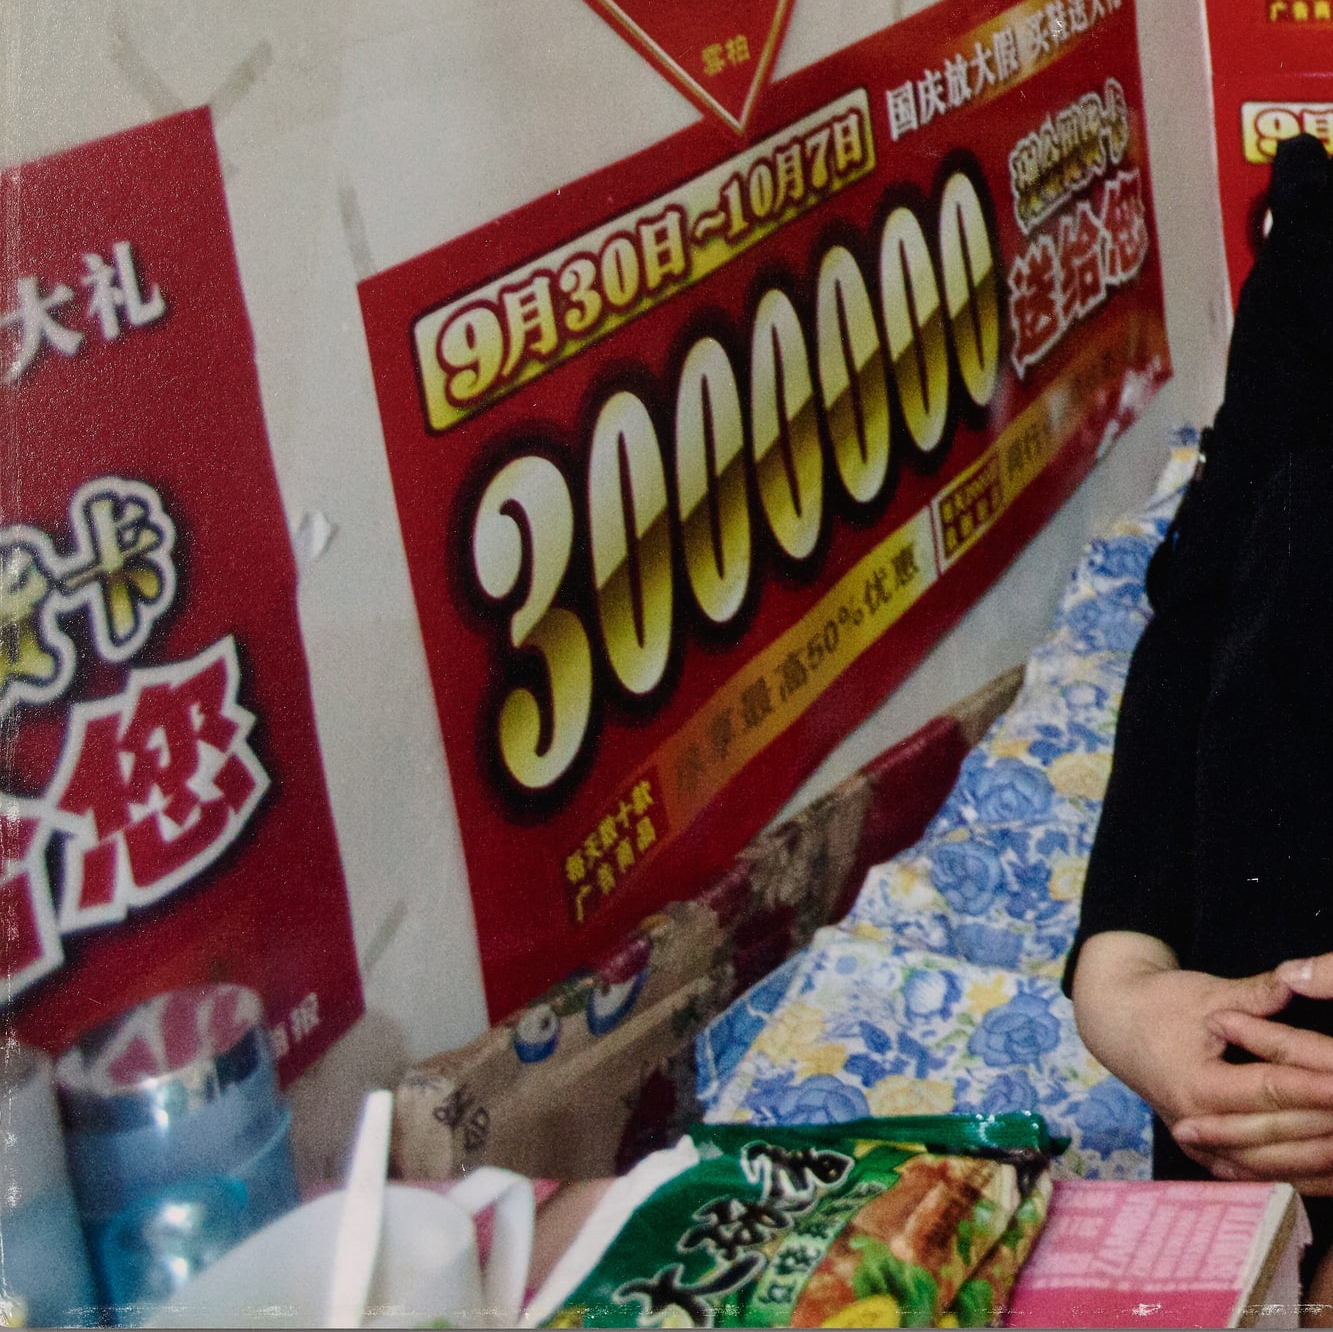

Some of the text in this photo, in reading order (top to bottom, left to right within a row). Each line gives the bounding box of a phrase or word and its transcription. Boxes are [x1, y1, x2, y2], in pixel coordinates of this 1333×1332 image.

[885, 28, 1020, 142] 国庆放大假
[0, 241, 166, 384] 大礼
[474, 170, 1001, 789] 3000000
